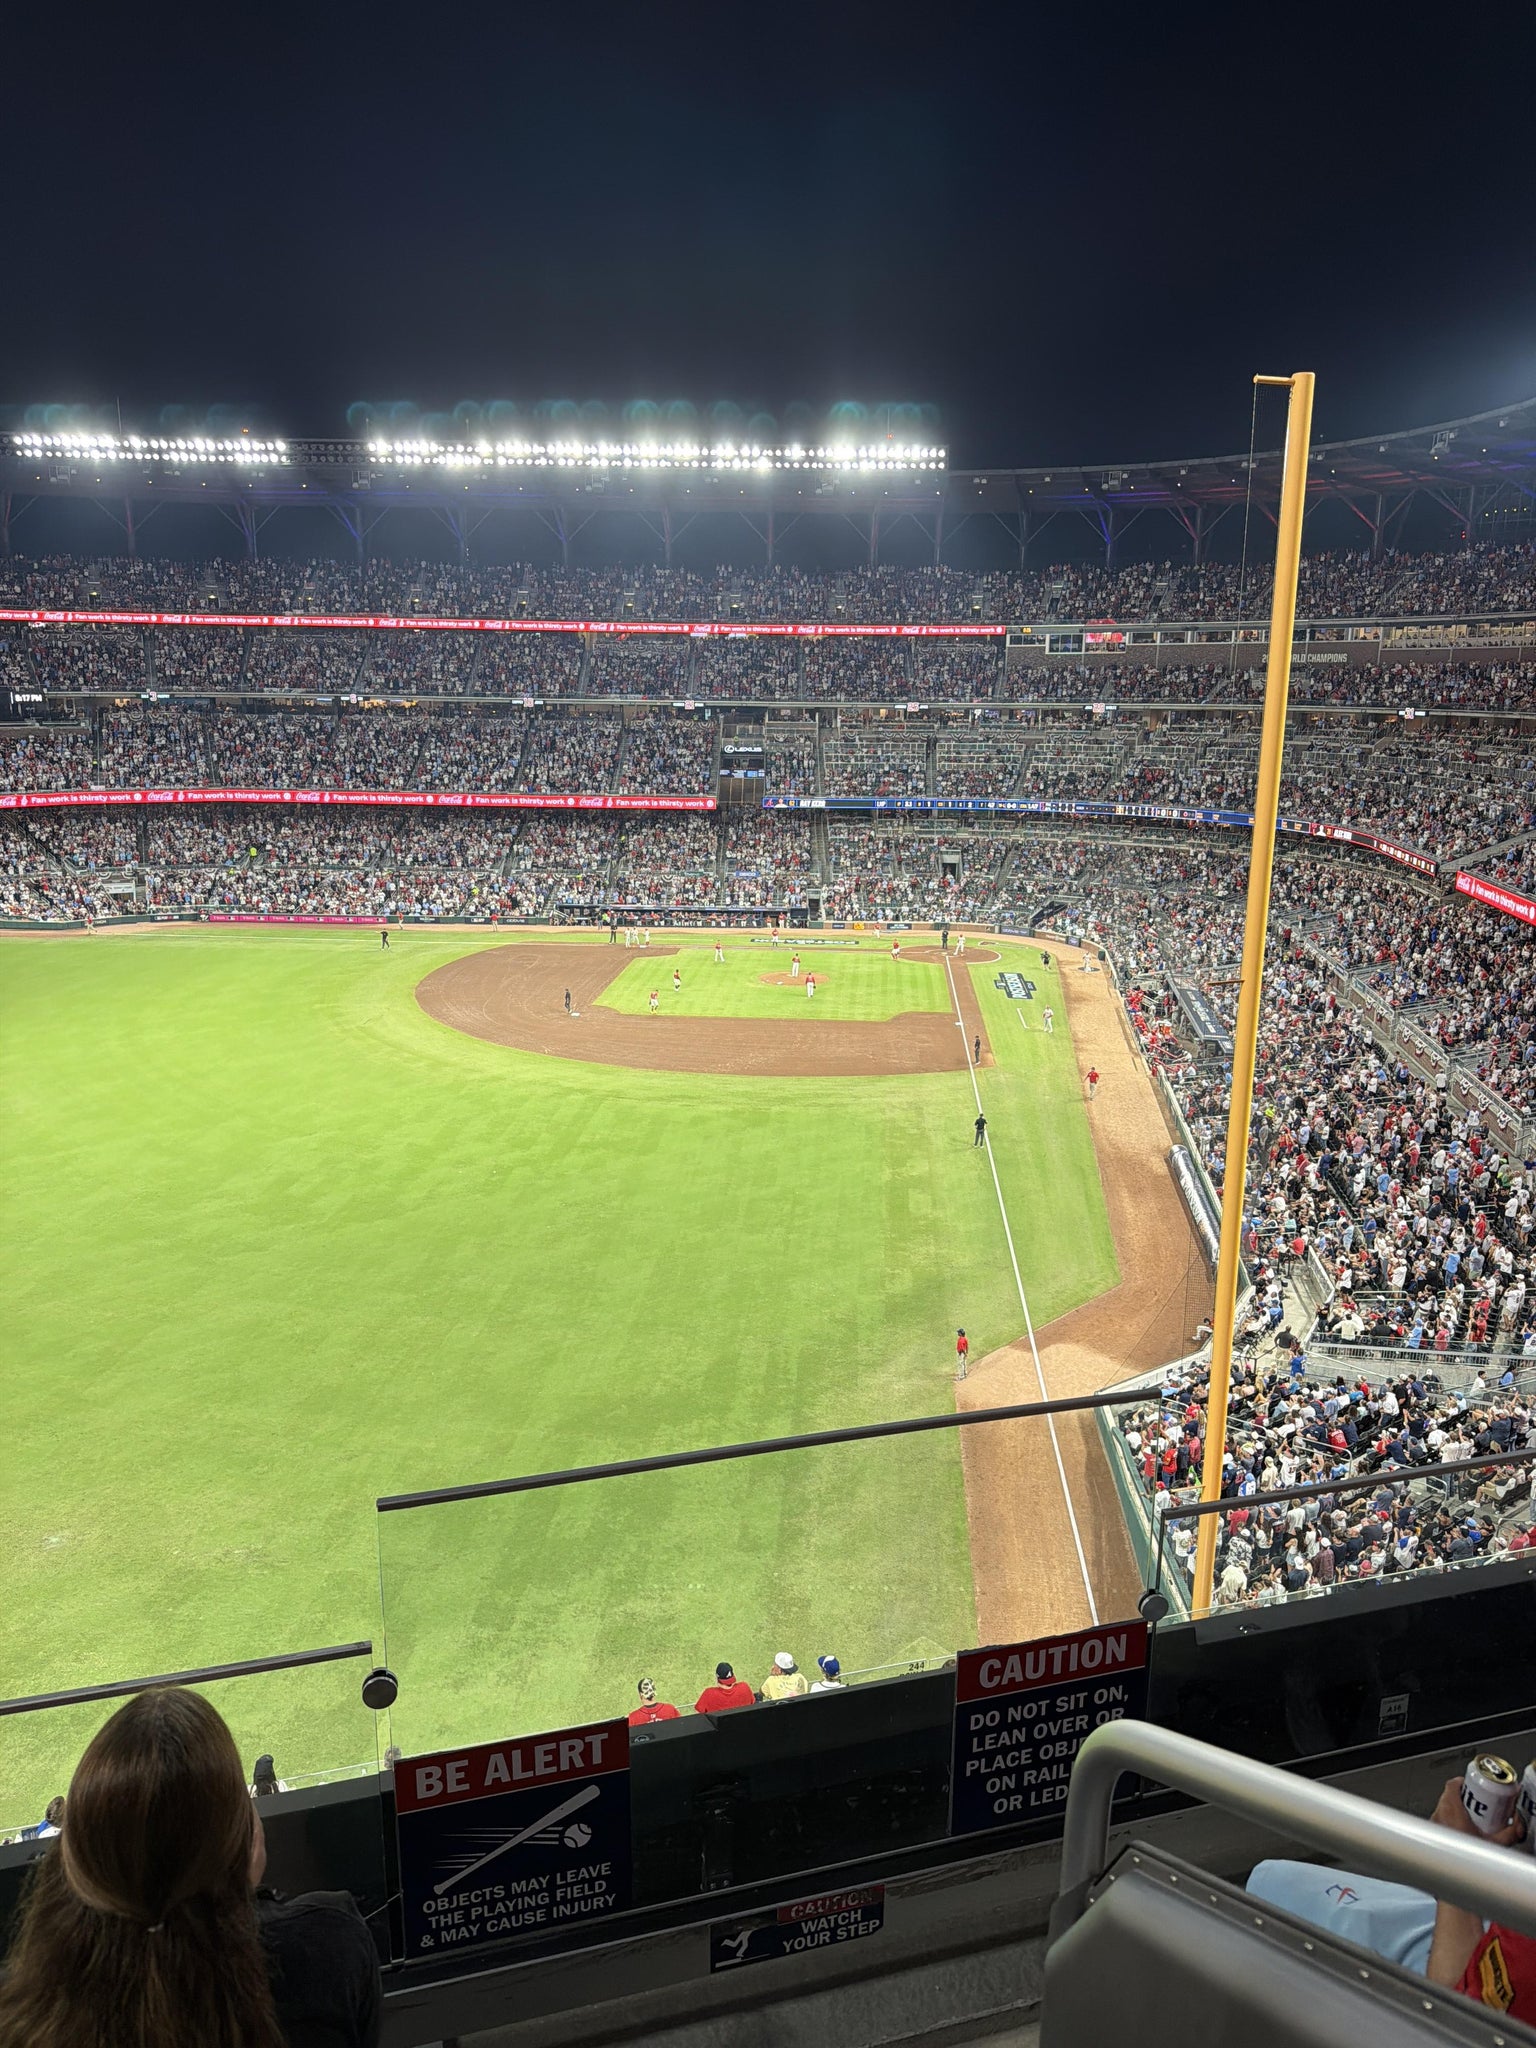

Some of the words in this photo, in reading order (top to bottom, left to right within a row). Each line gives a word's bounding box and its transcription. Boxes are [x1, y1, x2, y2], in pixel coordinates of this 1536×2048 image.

[1307, 653, 1348, 663] CHAMPIONS
[31, 693, 43, 702] PM
[79, 794, 107, 802] thirsty
[147, 791, 173, 800] Coca-Cola
[295, 791, 319, 801] Coca-Cola
[377, 794, 402, 802] thirsty
[438, 794, 463, 804] Coca-Cola
[518, 797, 544, 805] thirsty
[579, 797, 602, 806] Coca-Cola
[659, 799, 683, 807] thirsty
[1475, 884, 1485, 896] Fan
[1484, 888, 1496, 901] work
[1500, 894, 1516, 912] thirsty
[1515, 902, 1529, 915] work
[909, 1661, 925, 1671] 244
[978, 1633, 1128, 1689] CAUTION
[970, 1712, 1000, 1731] DO
[1007, 1701, 1050, 1723] NOT
[1055, 1692, 1088, 1713] SIT
[1093, 1684, 1129, 1705] ON,
[972, 1730, 1029, 1753] LEAN
[1034, 1716, 1089, 1739] OVER
[415, 1760, 471, 1800] BE
[484, 1731, 609, 1786] ALERT
[966, 1749, 1034, 1776] PLACE
[986, 1774, 1017, 1794] ON
[1023, 1765, 1074, 1786] RAIL
[993, 1795, 1024, 1813] OR
[1029, 1785, 1070, 1807] LED
[1461, 1785, 1488, 1817] ite
[423, 1885, 505, 1914] OBJECTS
[510, 1873, 552, 1896] MAY
[556, 1862, 611, 1887] LEAVE
[428, 1908, 466, 1928] THE
[471, 1892, 550, 1922] PLAYING
[555, 1880, 607, 1905] FIELD
[790, 1890, 873, 1920] CAUTION
[419, 1933, 435, 1948] &
[440, 1923, 481, 1944] MAY
[486, 1909, 547, 1936] CAUSE
[552, 1893, 616, 1922] INJURY
[801, 1909, 862, 1934] WATCH
[783, 1932, 831, 1953] YOUR
[837, 1919, 880, 1940] STEP
